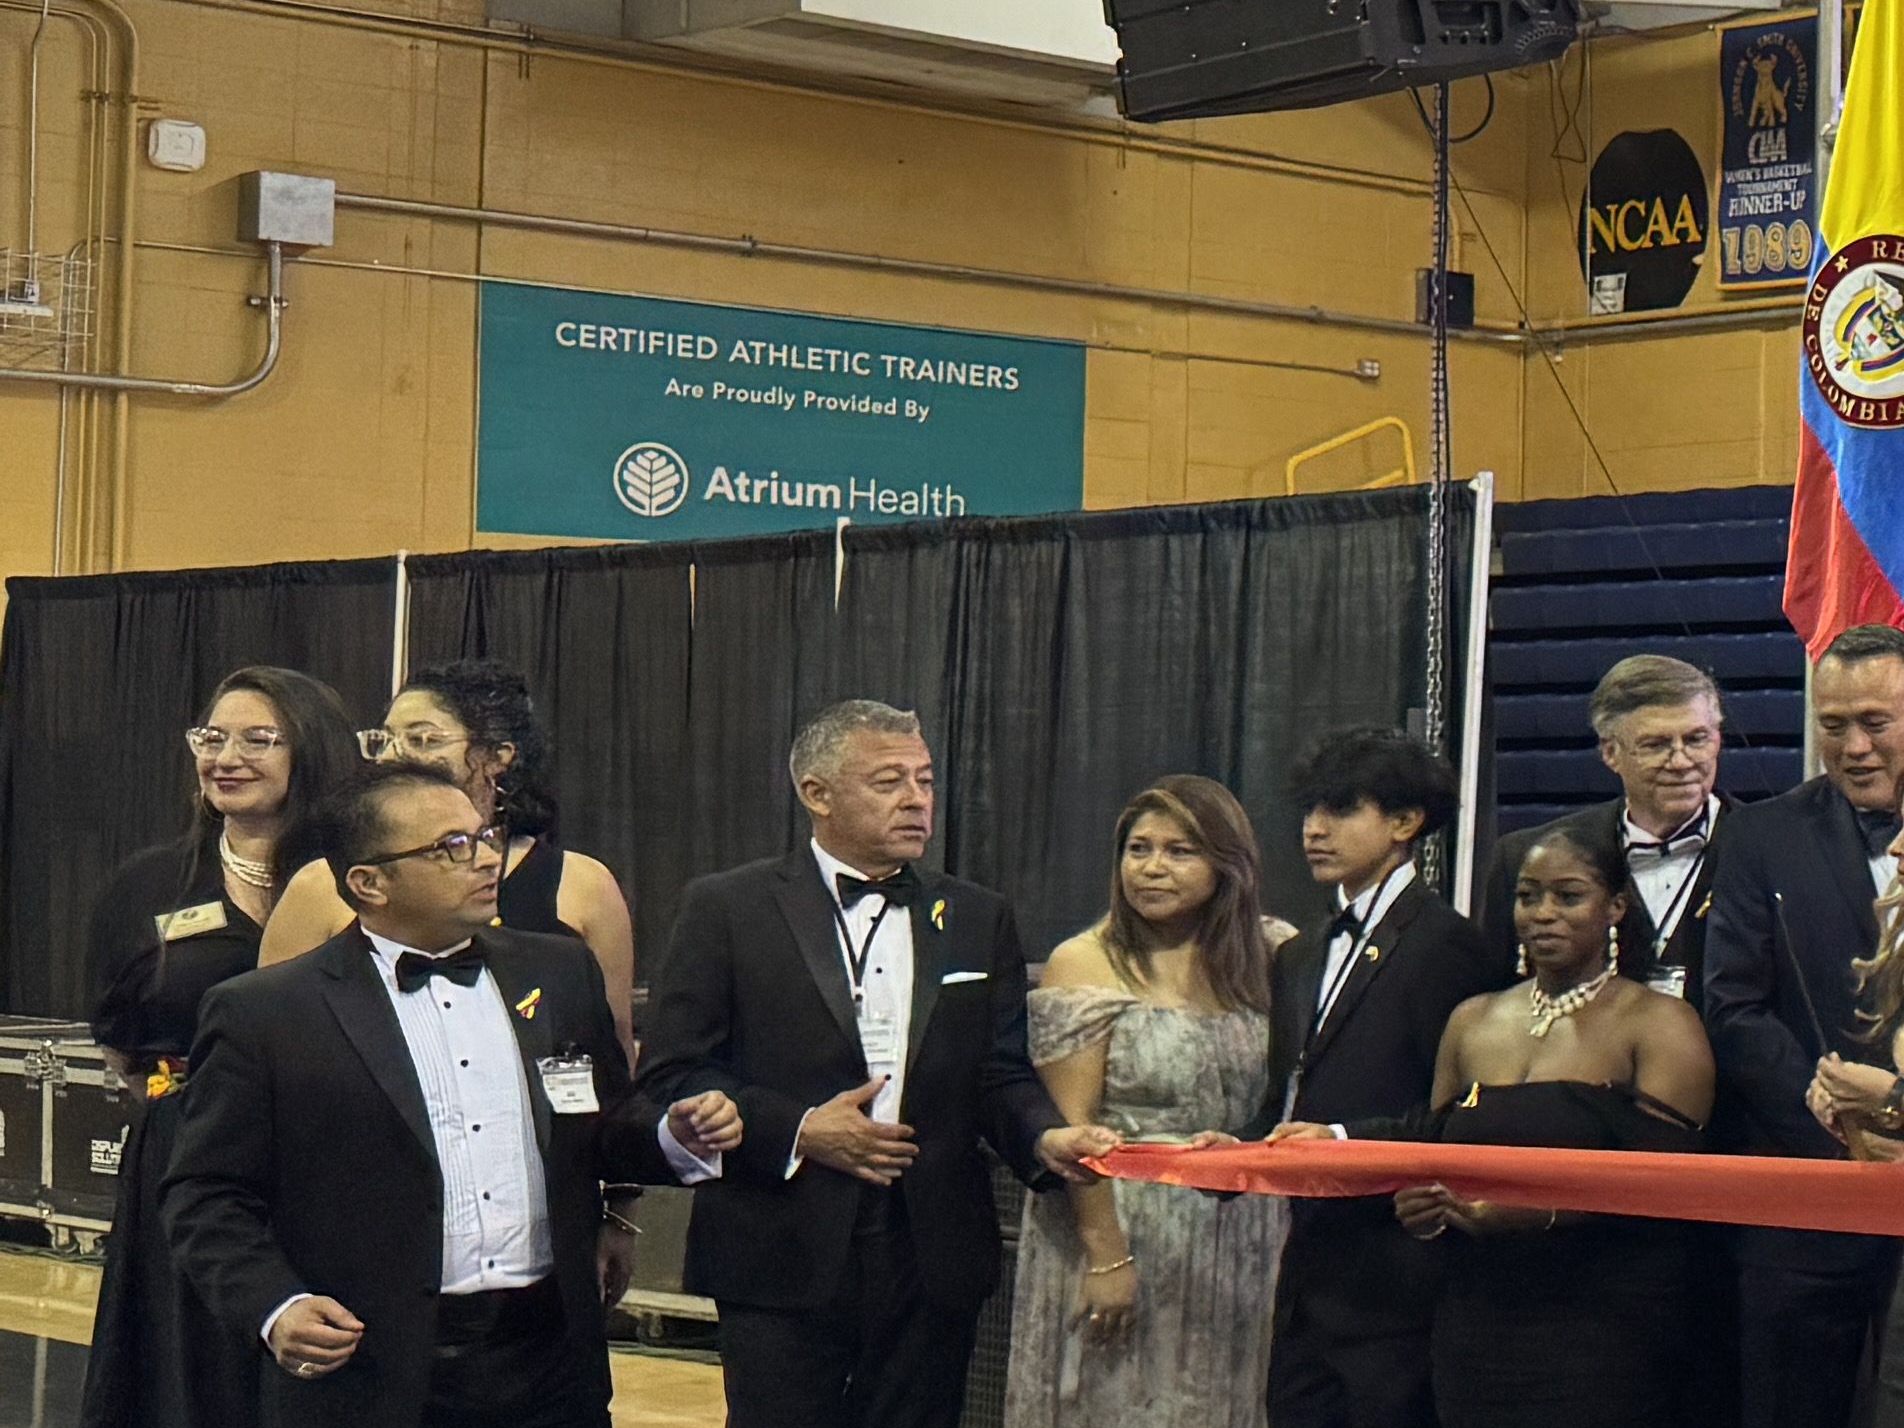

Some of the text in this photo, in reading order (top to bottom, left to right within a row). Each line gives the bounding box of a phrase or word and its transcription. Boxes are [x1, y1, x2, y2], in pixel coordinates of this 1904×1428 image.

[1590, 193, 1703, 255] NCAA
[1722, 219, 1813, 275] 1989
[1806, 282, 1828, 323] DE
[554, 321, 1021, 392] CERTIFIED ATHLETIC TRAINERS
[664, 378, 930, 423] Are Proudly Provided By
[704, 465, 967, 518] Atrium Health
